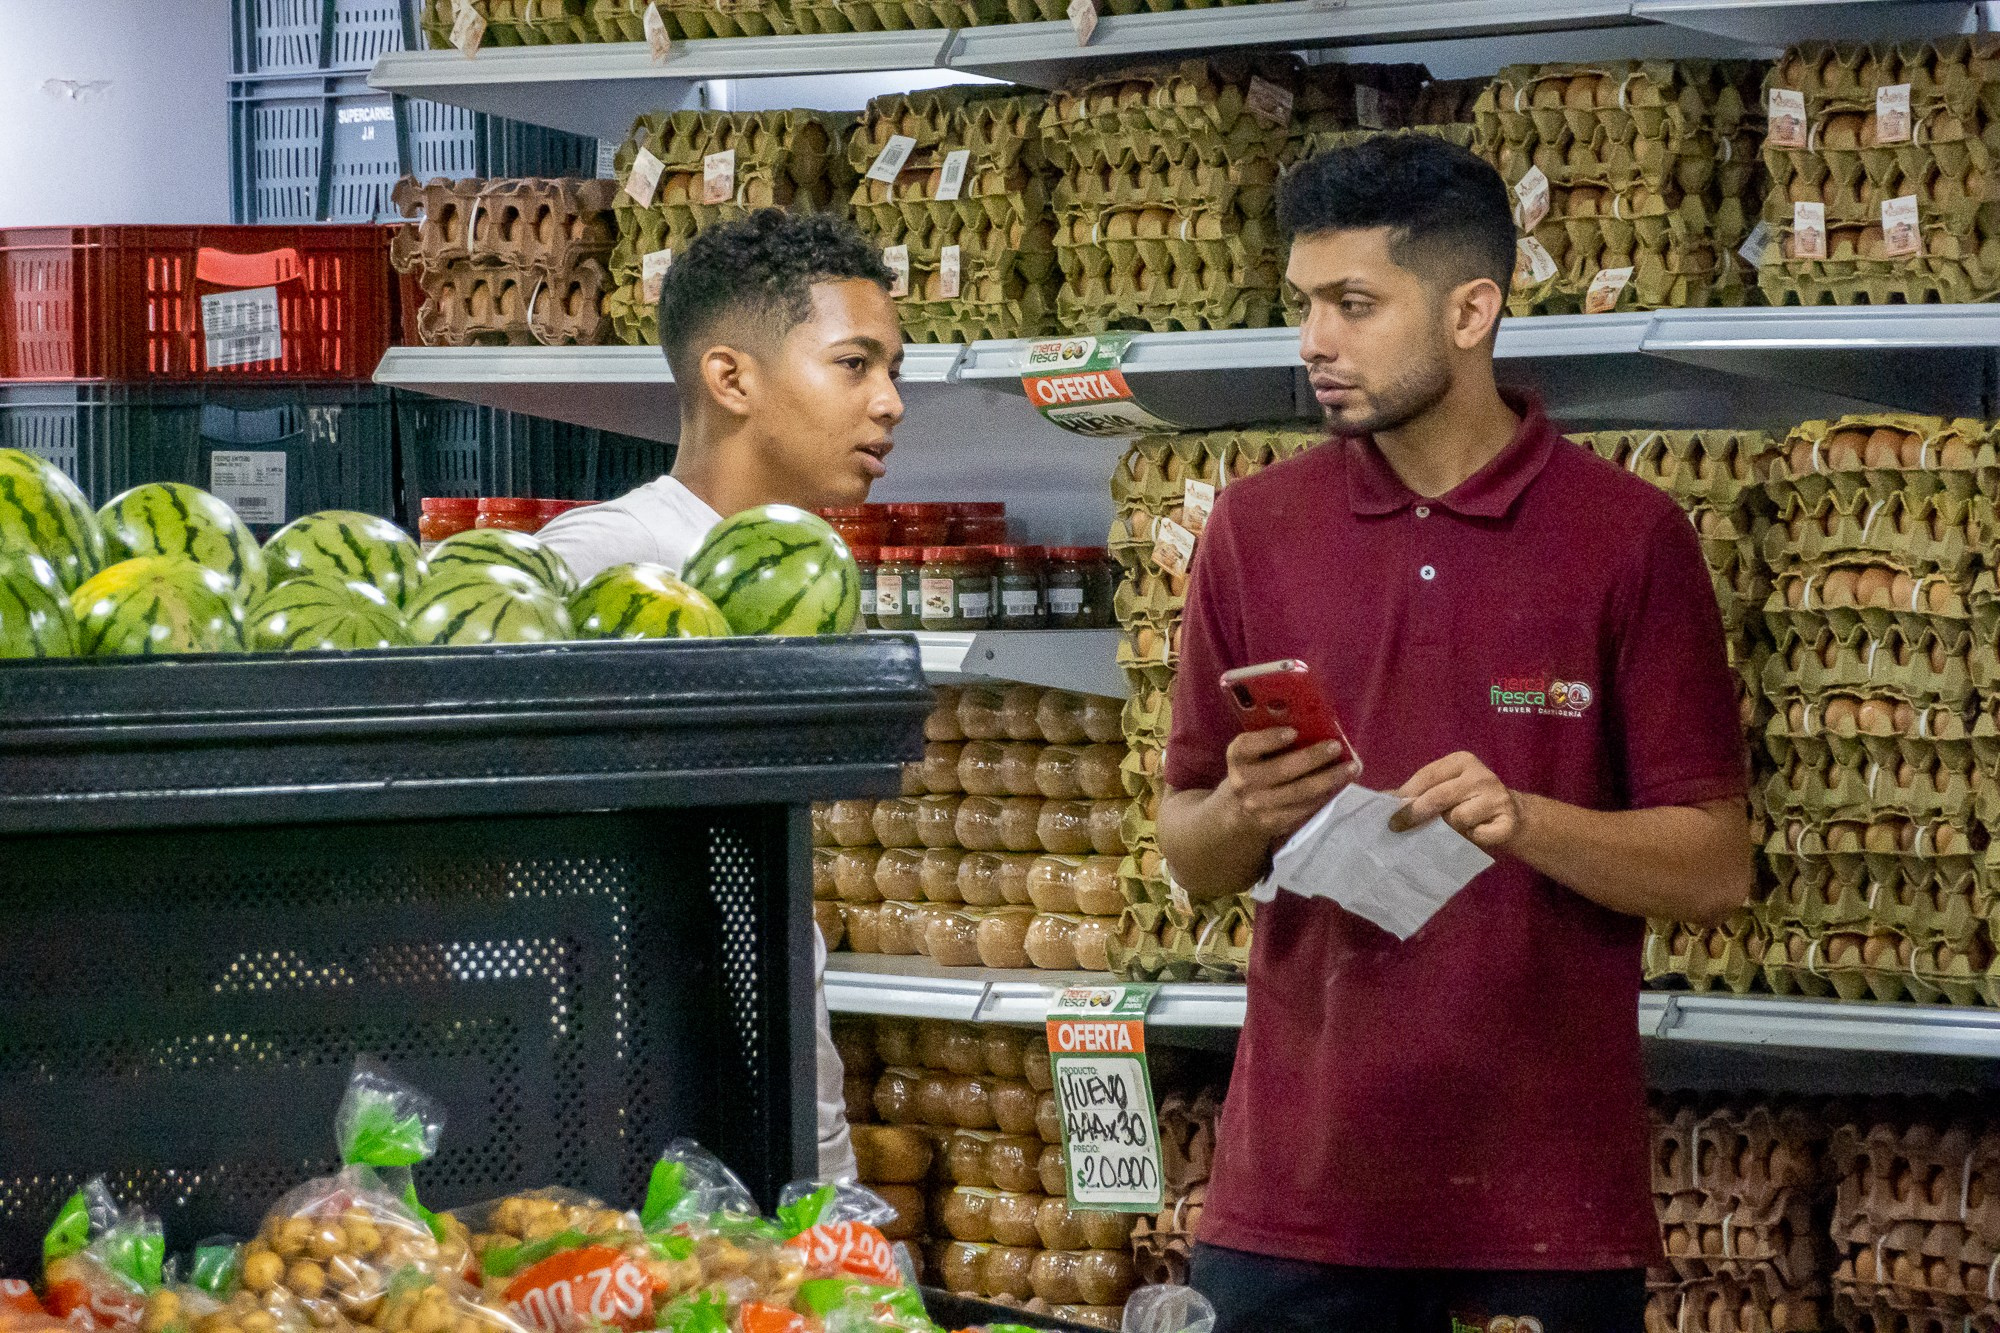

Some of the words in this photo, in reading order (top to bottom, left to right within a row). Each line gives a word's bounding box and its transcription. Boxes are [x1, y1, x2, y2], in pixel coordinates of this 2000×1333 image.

[1032, 342, 1062, 354] merca
[1029, 350, 1059, 364] fresca
[1036, 373, 1121, 404] OFERTA
[1490, 685, 1546, 706] fresca
[1057, 994, 1088, 1008] fresca
[1058, 1023, 1134, 1051] OFERTA
[1060, 1074, 1129, 1112] HUEVO
[1073, 1144, 1100, 1153] PRECIO:
